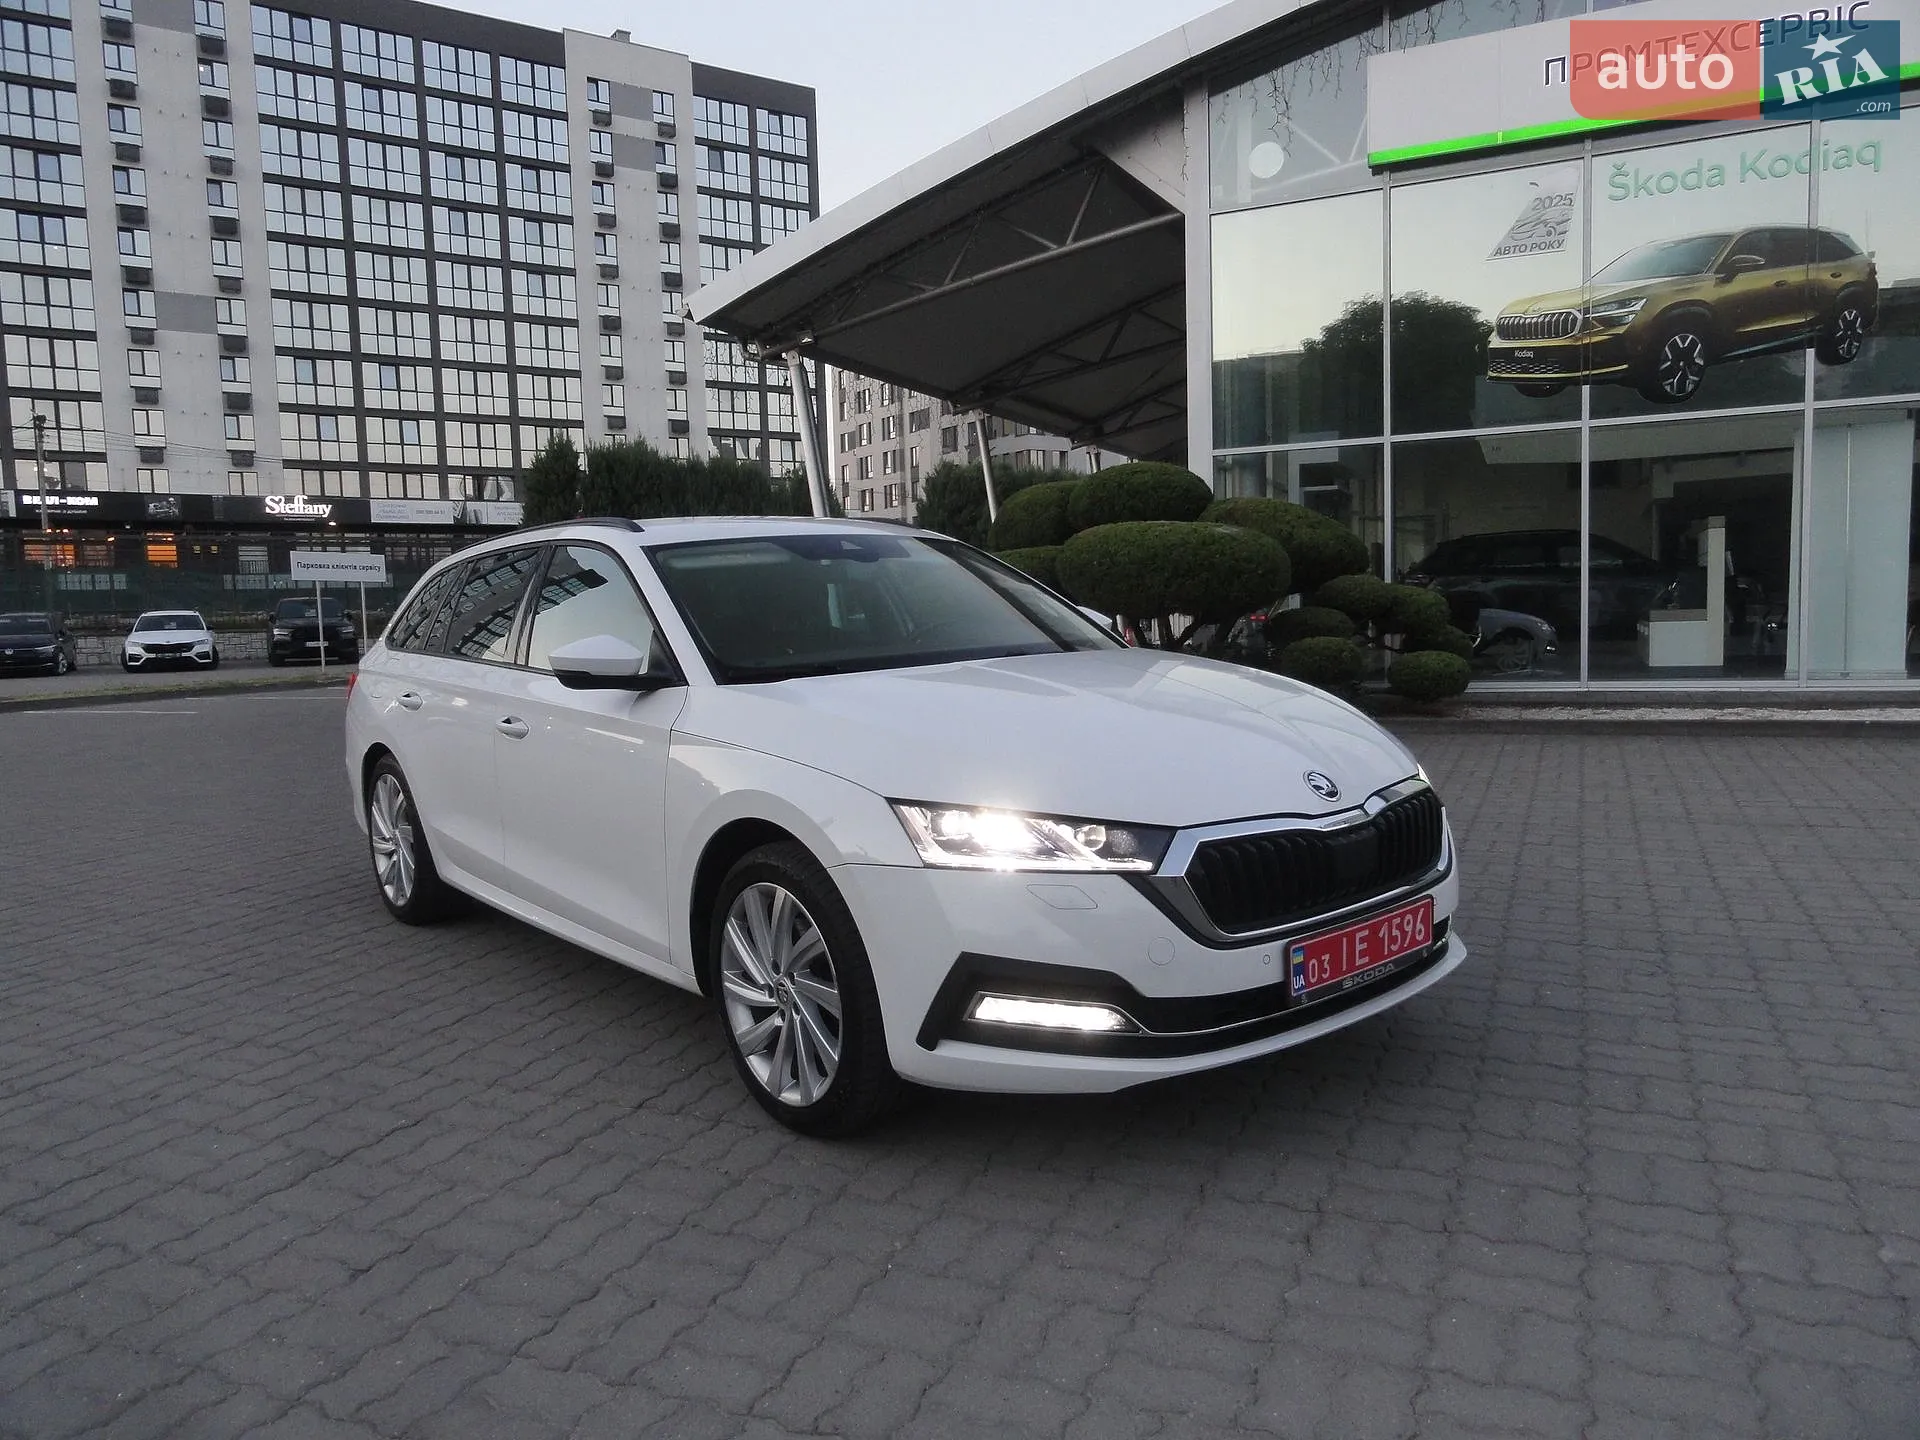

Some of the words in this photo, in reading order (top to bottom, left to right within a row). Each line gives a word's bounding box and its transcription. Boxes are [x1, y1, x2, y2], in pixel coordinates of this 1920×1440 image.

[1608, 158, 1726, 201] Škoda
[1739, 139, 1882, 183] Kodiaq
[1532, 193, 1575, 211] 2025
[1493, 243, 1528, 257] АВТО
[1530, 239, 1565, 252] РОКУ
[265, 494, 333, 518] Steffany
[296, 561, 330, 571] Парковка
[358, 564, 381, 573] сервісу
[1308, 953, 1331, 984] 03
[1341, 929, 1370, 972] IE
[1378, 907, 1426, 956] 1596
[1292, 974, 1306, 990] UA
